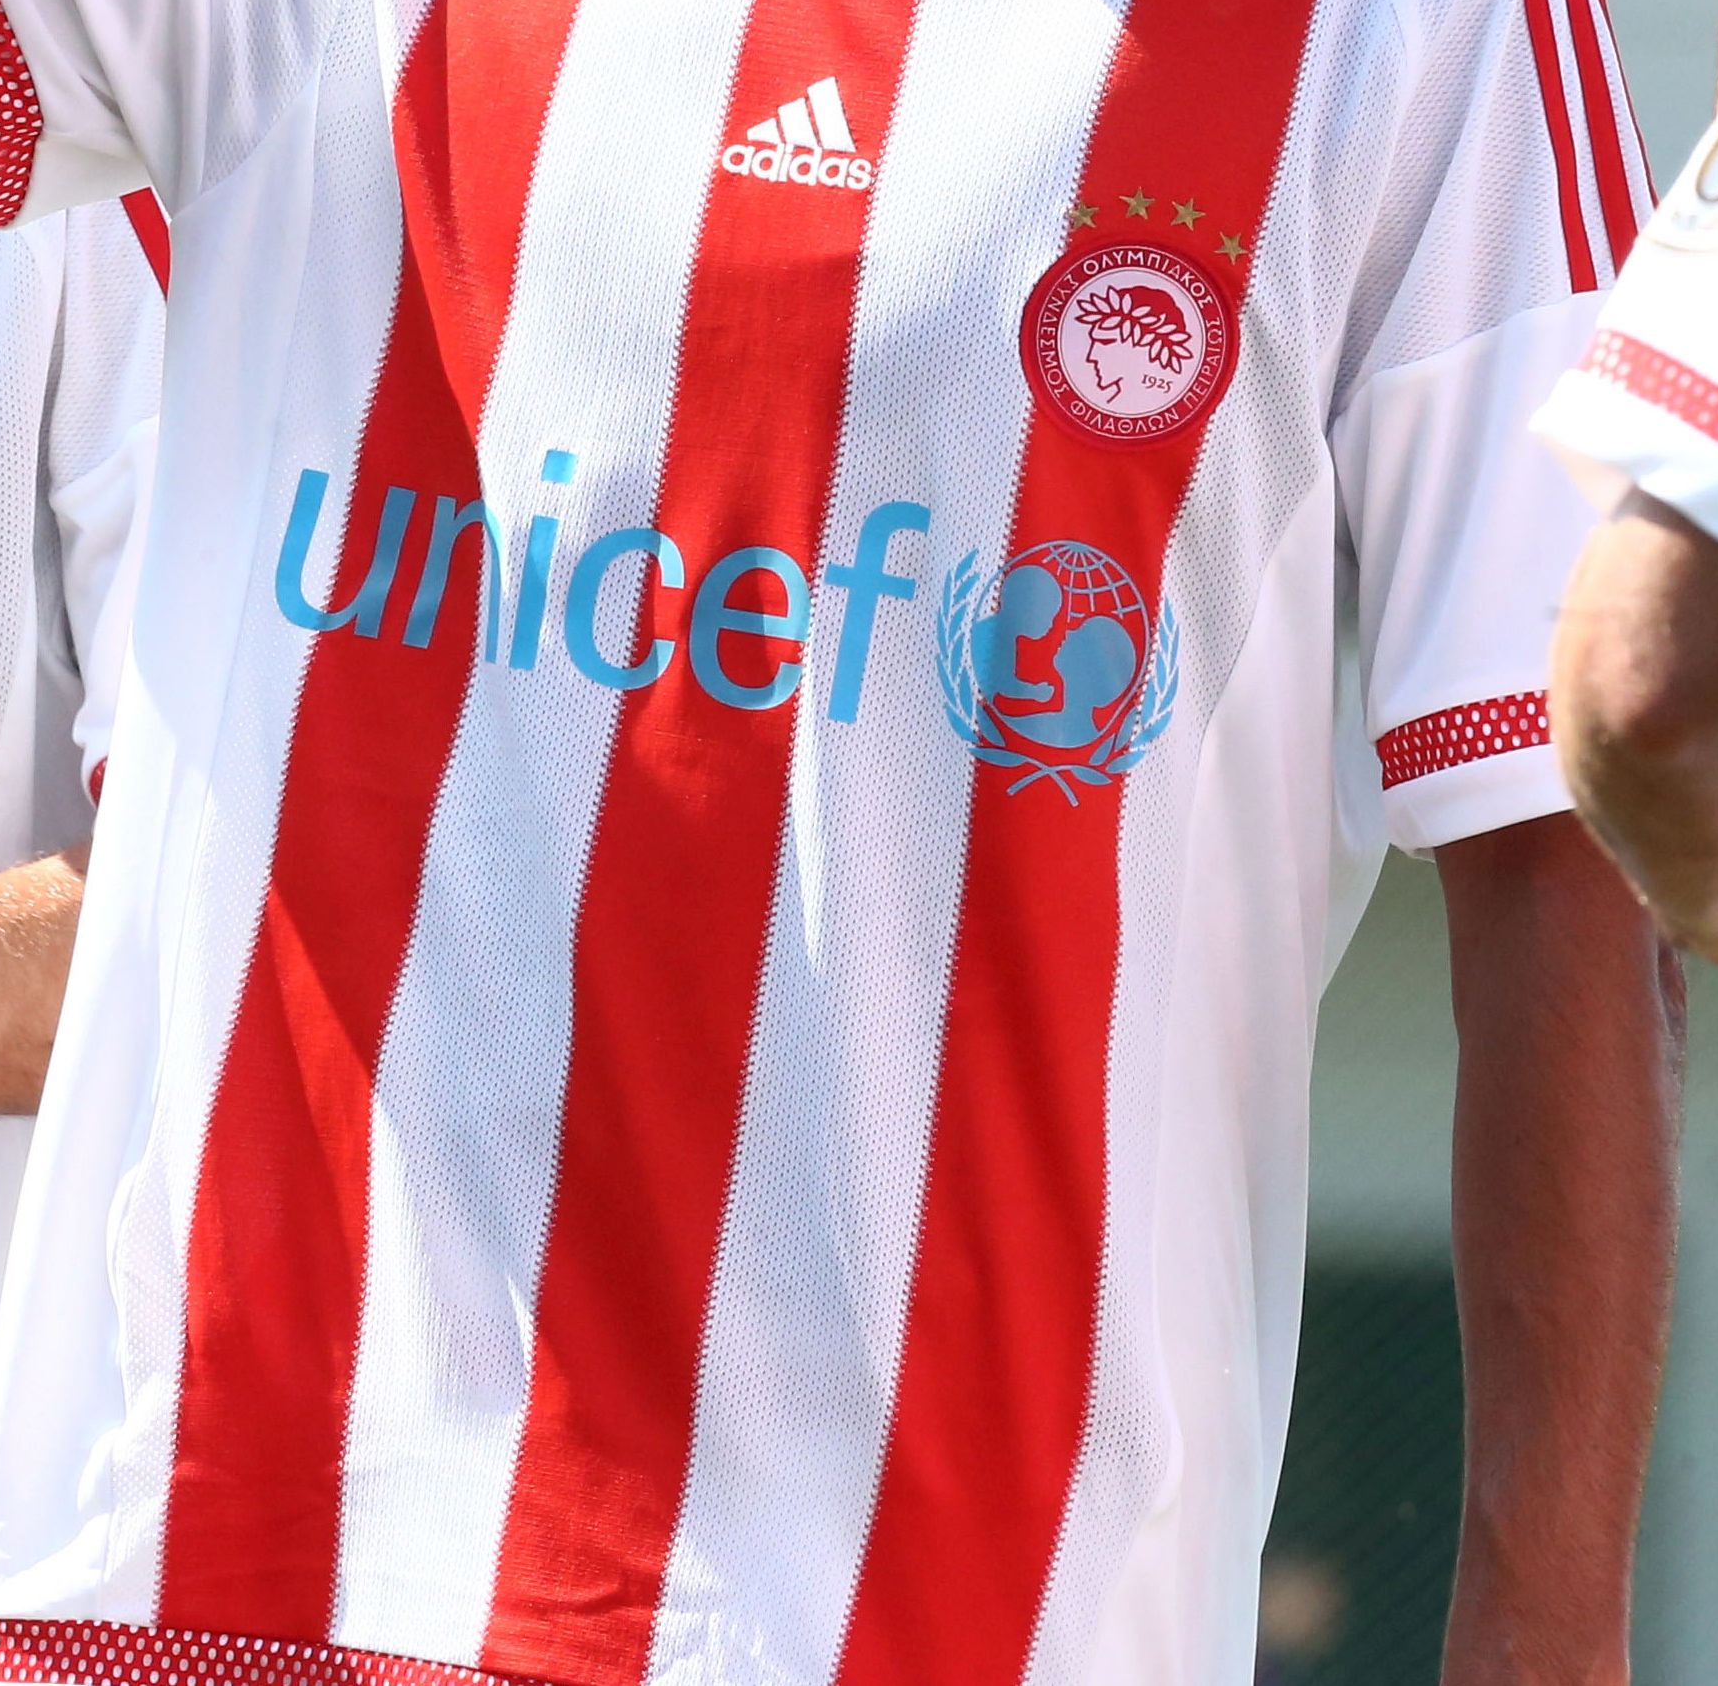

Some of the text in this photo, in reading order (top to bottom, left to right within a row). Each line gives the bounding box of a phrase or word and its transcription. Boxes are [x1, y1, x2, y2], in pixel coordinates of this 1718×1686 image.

[722, 142, 873, 190] adidas
[1082, 250, 1214, 309] ΟΛΥΜΠΙΑΚΟΣ
[1040, 274, 1080, 399] ΣΥΝΔΕΣΜΟΣ
[1141, 374, 1174, 394] 1925
[1070, 399, 1180, 433] ΦΙΛΑΘΛΩΝ
[273, 448, 933, 723] unicef
